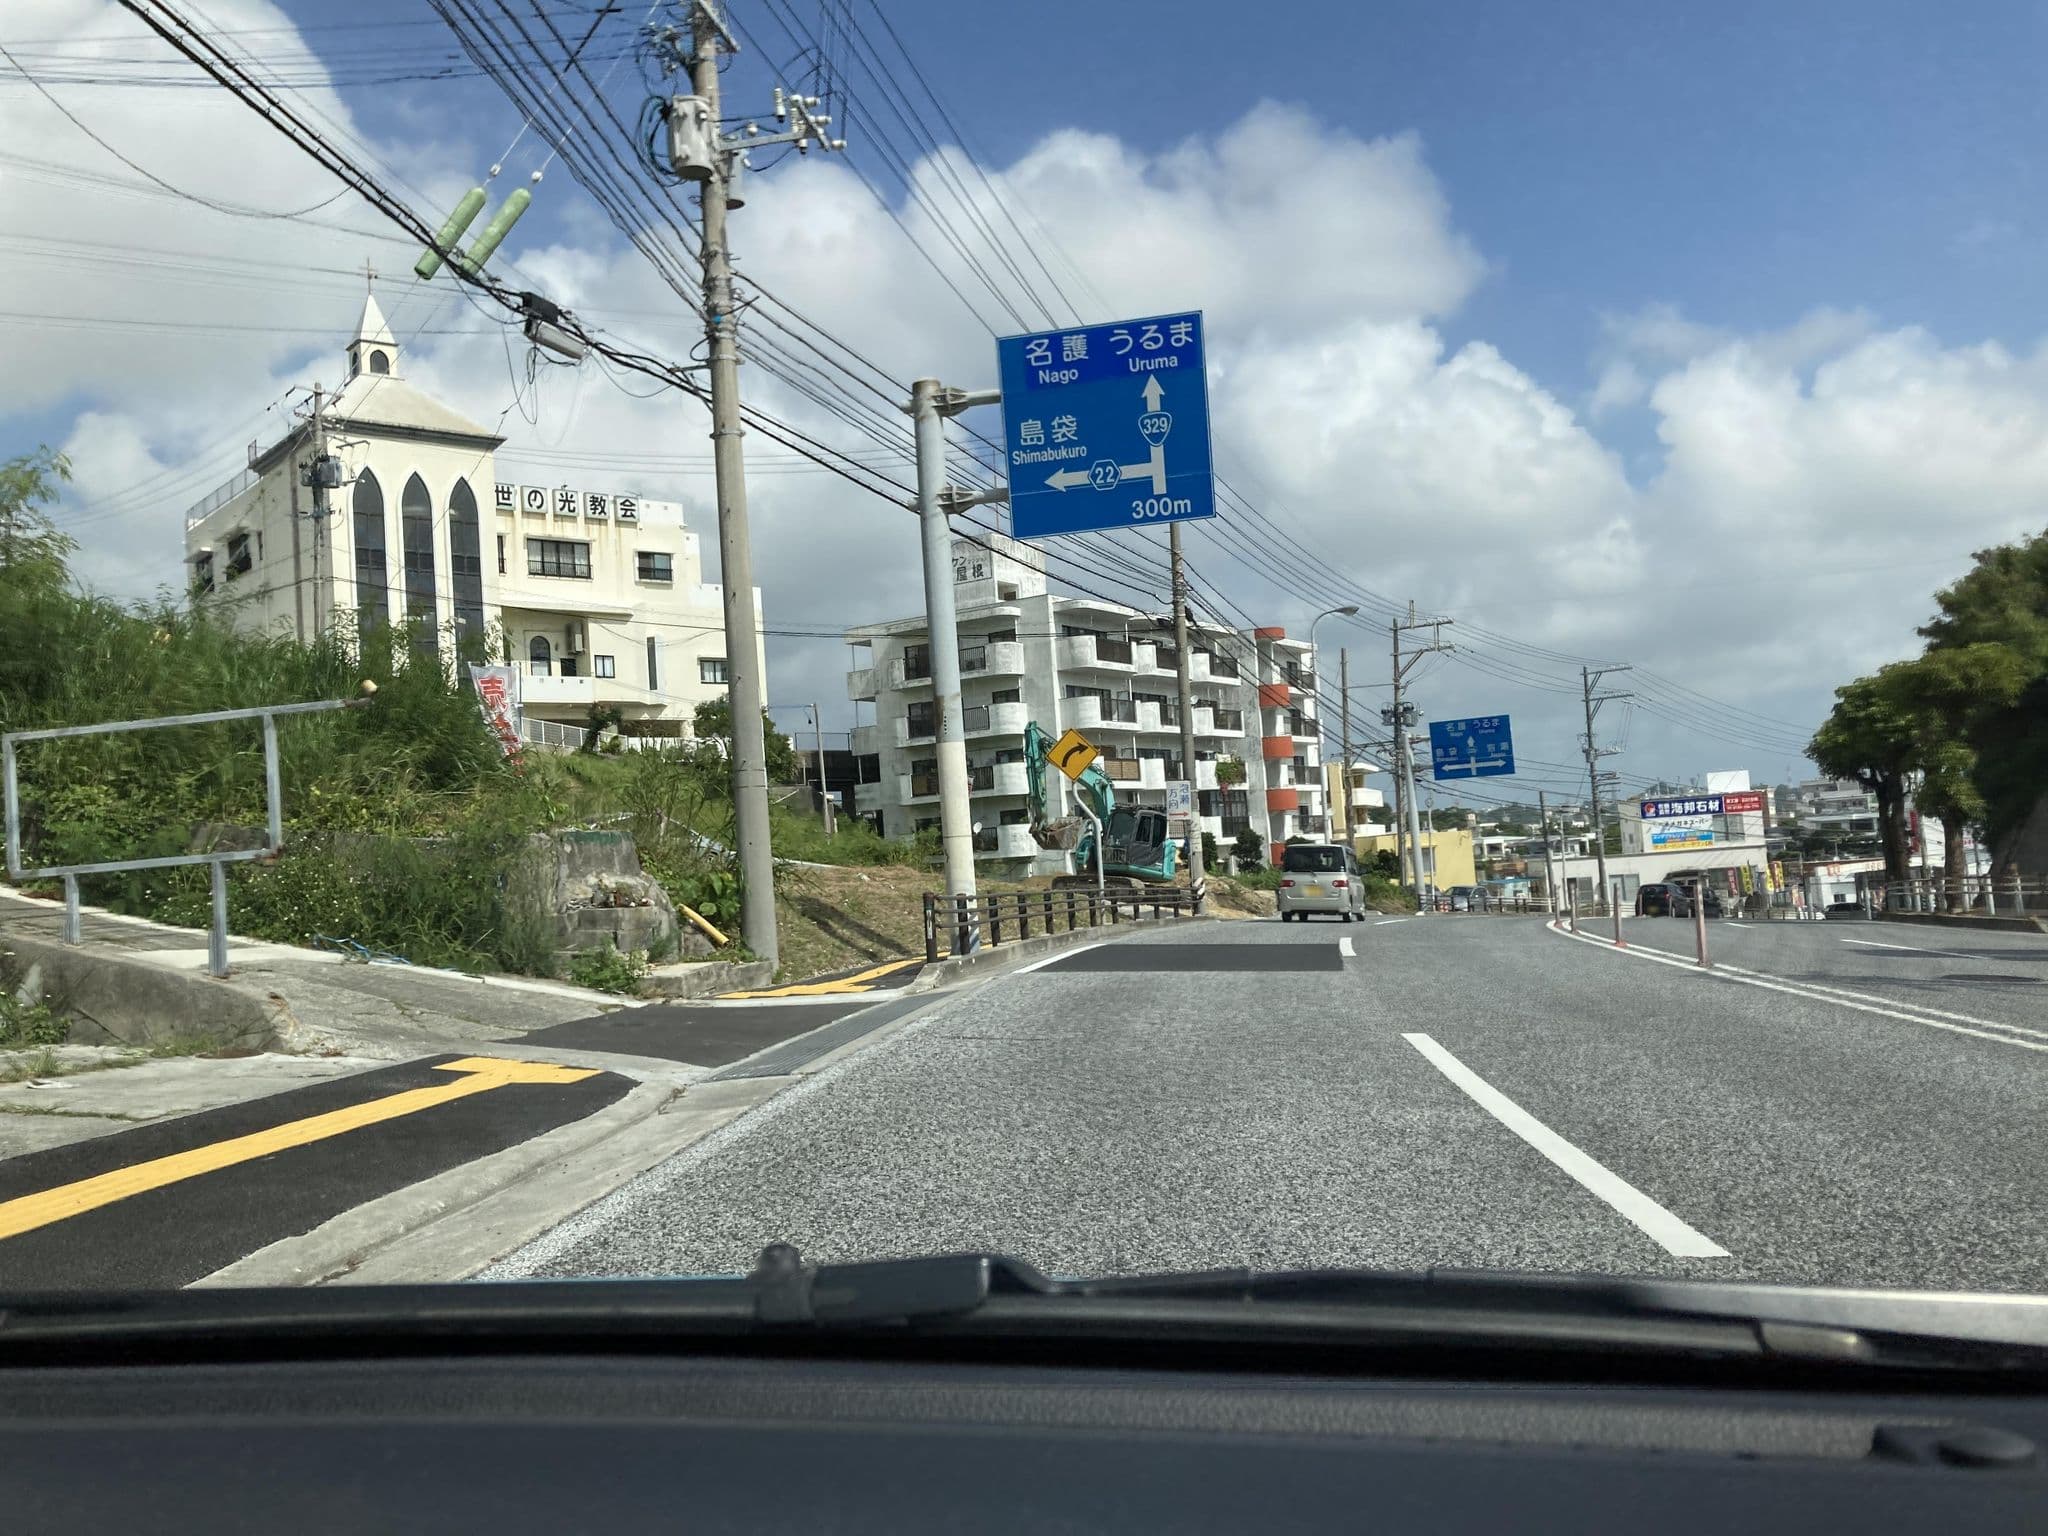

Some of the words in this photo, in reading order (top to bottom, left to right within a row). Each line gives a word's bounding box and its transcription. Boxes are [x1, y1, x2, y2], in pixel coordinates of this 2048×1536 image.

[1025, 334, 1088, 366] 名護
[1109, 321, 1193, 355] うるま
[1038, 367, 1079, 384] Nago
[1128, 355, 1178, 373] Uruma
[1020, 415, 1078, 446] 島袋
[1143, 417, 1168, 435] 329
[1012, 445, 1087, 465] Shimabukuro
[1094, 467, 1115, 484] 22
[495, 484, 637, 520] 世の光教会
[1131, 497, 1191, 519] 300m
